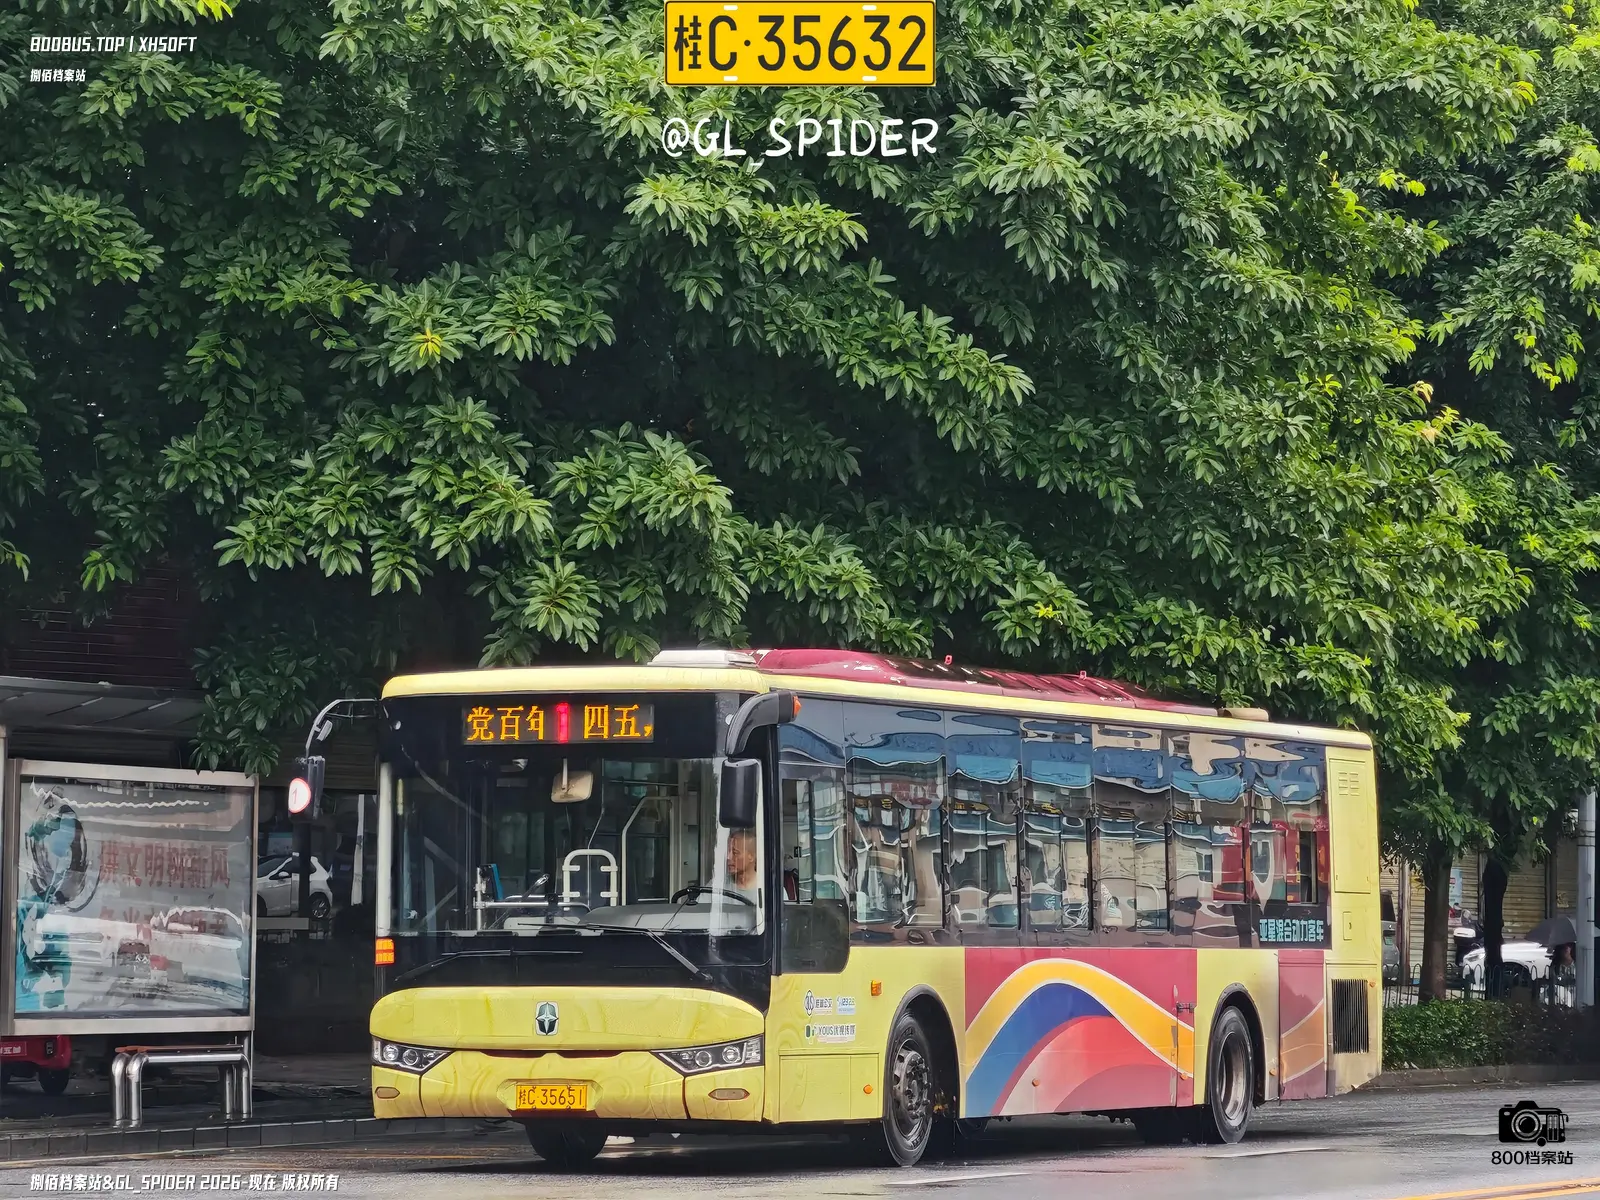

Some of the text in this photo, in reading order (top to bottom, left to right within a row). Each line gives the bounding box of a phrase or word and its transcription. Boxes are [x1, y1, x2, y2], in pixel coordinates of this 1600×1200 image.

[555, 702, 570, 744] 1
[1259, 918, 1325, 942] 亚星混合动力客车
